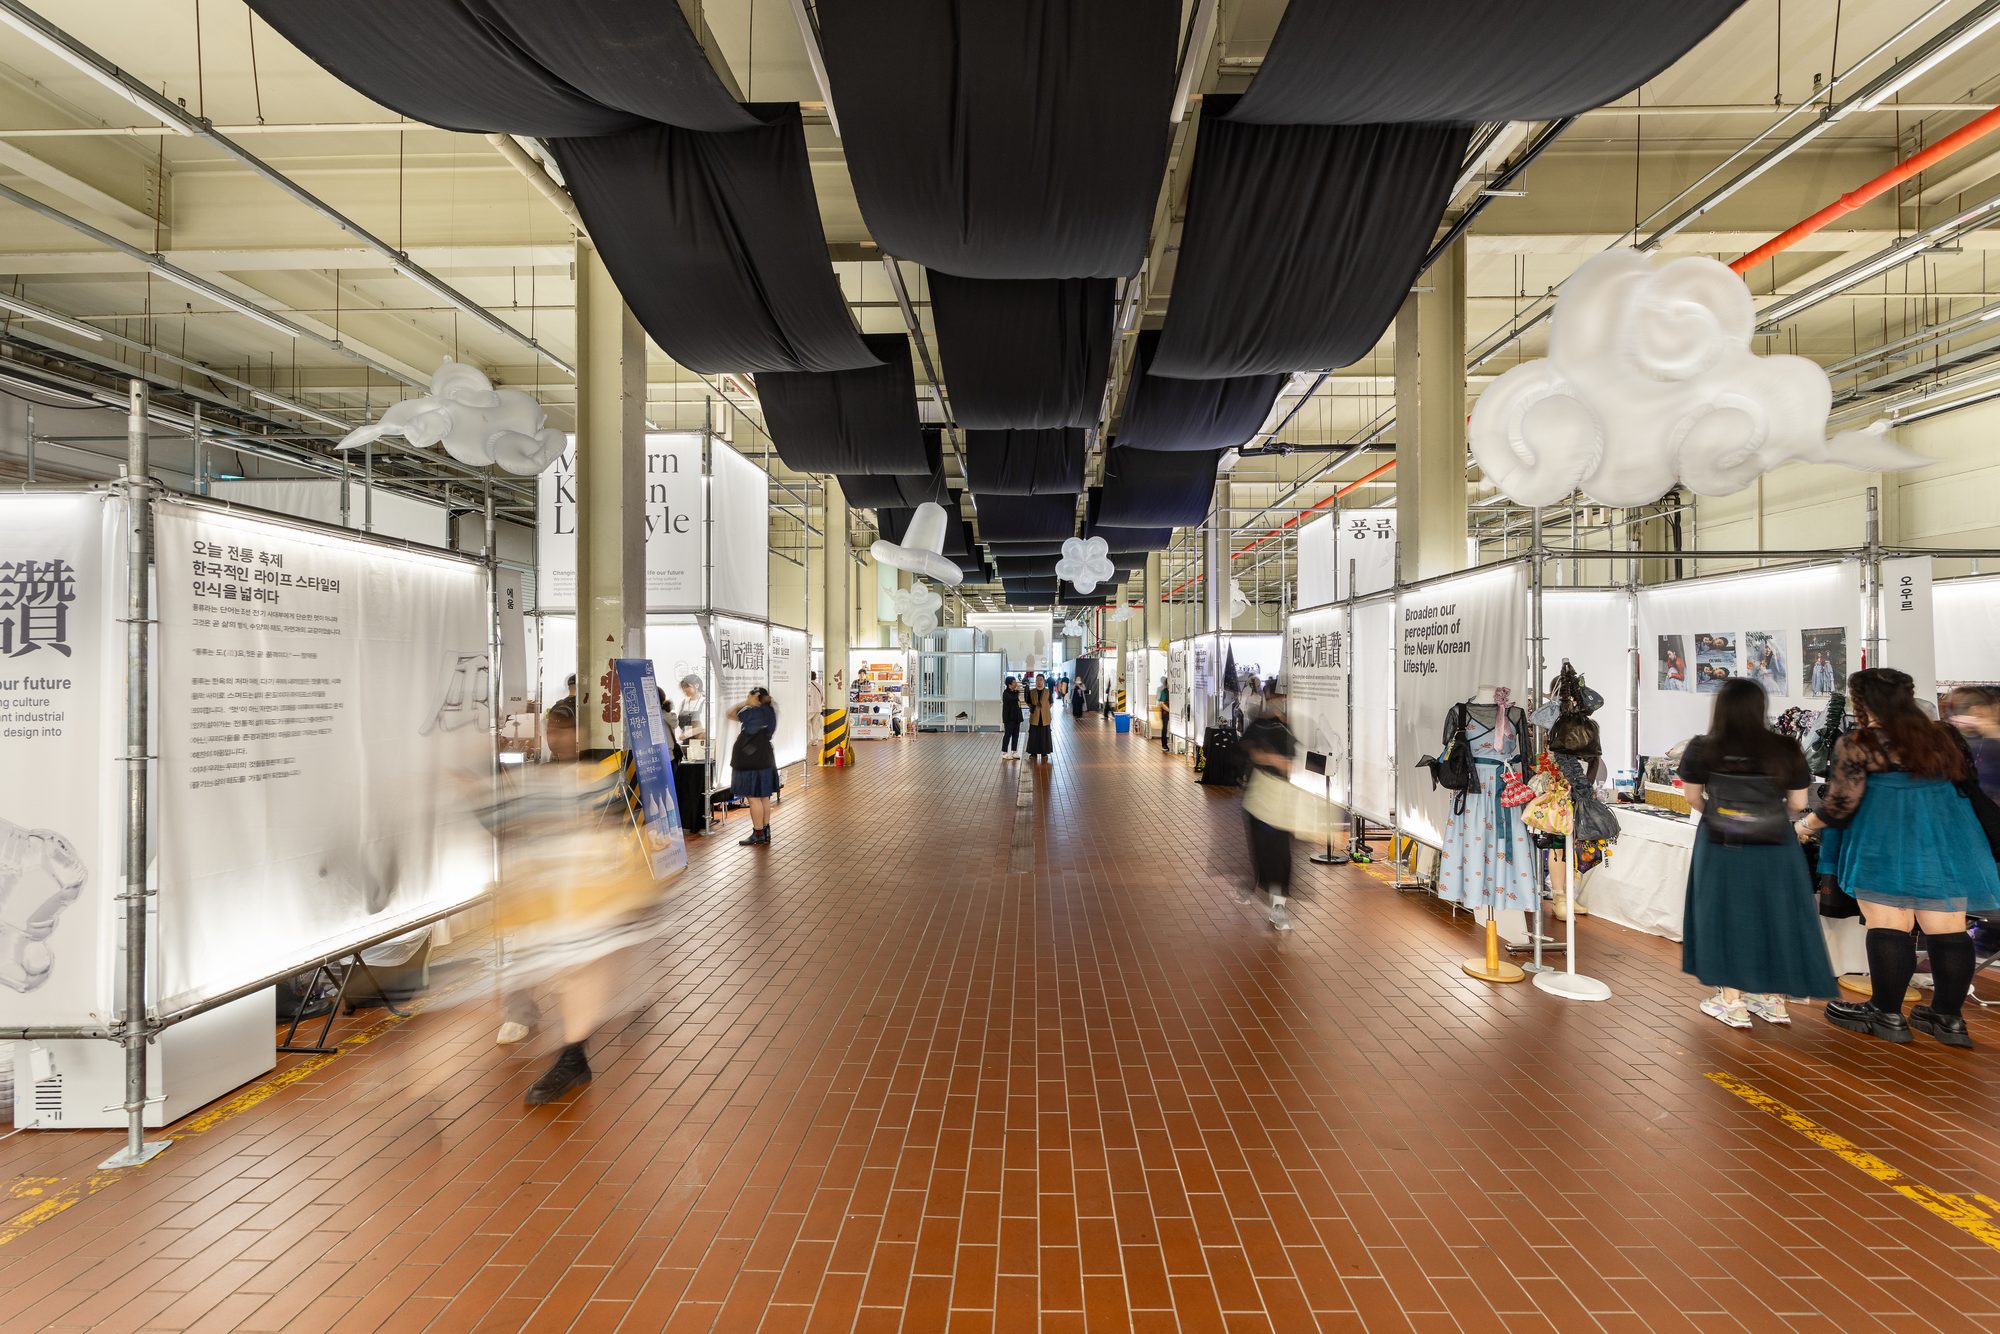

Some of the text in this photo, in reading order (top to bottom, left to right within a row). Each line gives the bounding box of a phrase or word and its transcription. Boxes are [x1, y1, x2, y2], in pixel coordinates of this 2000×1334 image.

[1348, 518, 1392, 540] 풍류
[193, 540, 283, 568] 오늘 전통 축제
[193, 560, 340, 593] 한국적인 라이프 스타일의
[193, 581, 280, 604] 인식을 넓히다
[1900, 576, 1914, 611] 오우르
[220, 606, 241, 615] 단어는
[252, 609, 266, 617] 전기
[1406, 604, 1456, 621] Broaden our
[1404, 619, 1461, 641] perception of
[1404, 640, 1470, 656] the New Korean
[1403, 660, 1438, 676] Lifestyle.
[24, 676, 71, 690] future
[12, 697, 50, 707] culture
[15, 712, 64, 722] industrial
[4, 727, 62, 739] design into
